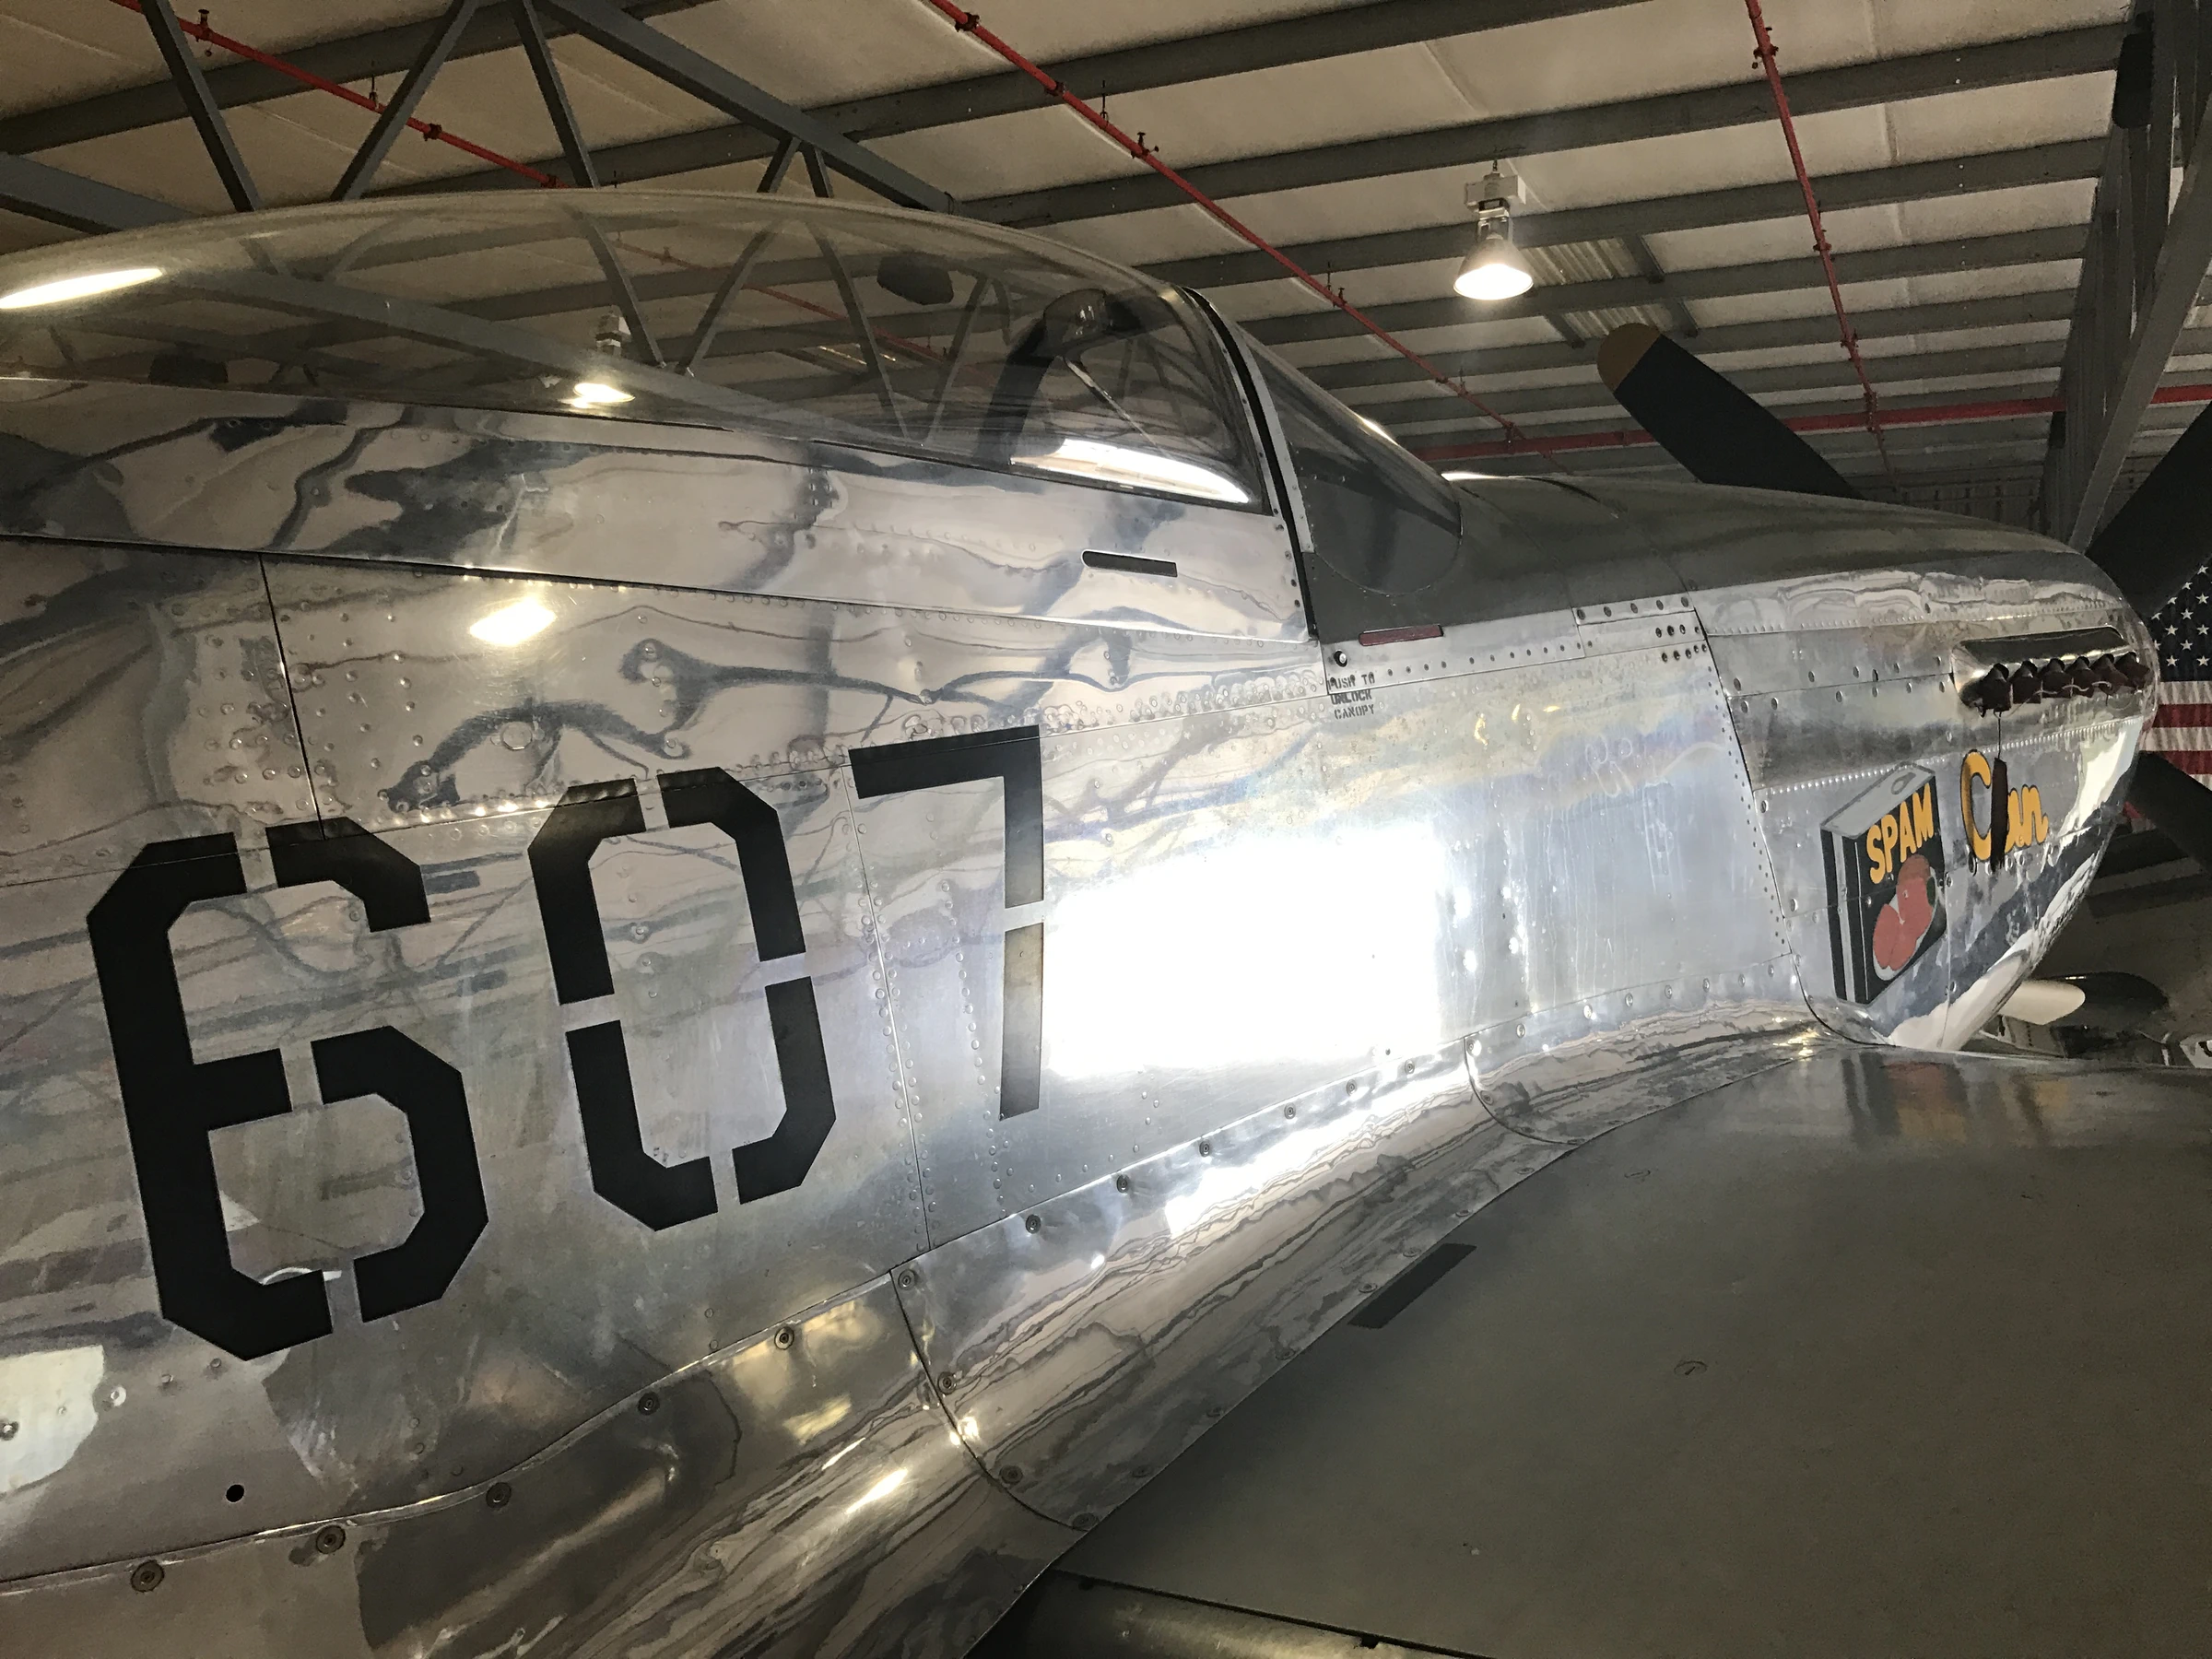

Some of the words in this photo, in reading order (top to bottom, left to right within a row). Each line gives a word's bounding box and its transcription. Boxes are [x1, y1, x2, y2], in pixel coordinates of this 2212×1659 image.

[1327, 677, 1356, 690] PUSH
[1361, 672, 1375, 685] TO
[1331, 689, 1372, 705] UNLOCK
[1334, 704, 1374, 720] CANOPY
[1865, 783, 1934, 884] SPAM
[87, 724, 1044, 1361] 607
